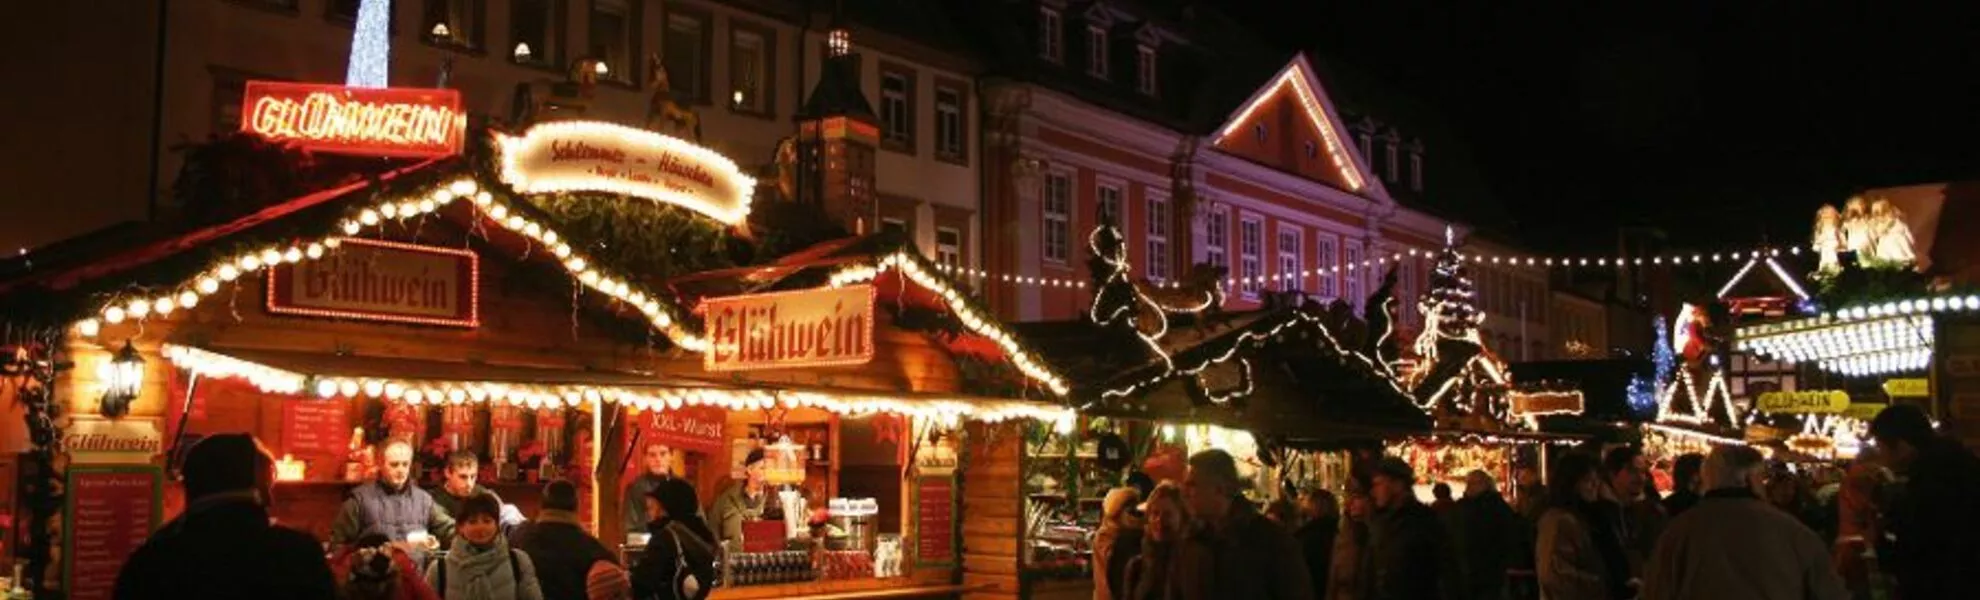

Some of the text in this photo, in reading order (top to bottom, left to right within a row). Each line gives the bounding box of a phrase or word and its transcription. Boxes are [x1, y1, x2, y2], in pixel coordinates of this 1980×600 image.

[304, 253, 447, 309] Glühwein
[714, 300, 867, 363] Glühwein
[64, 433, 160, 451] Glühwein
